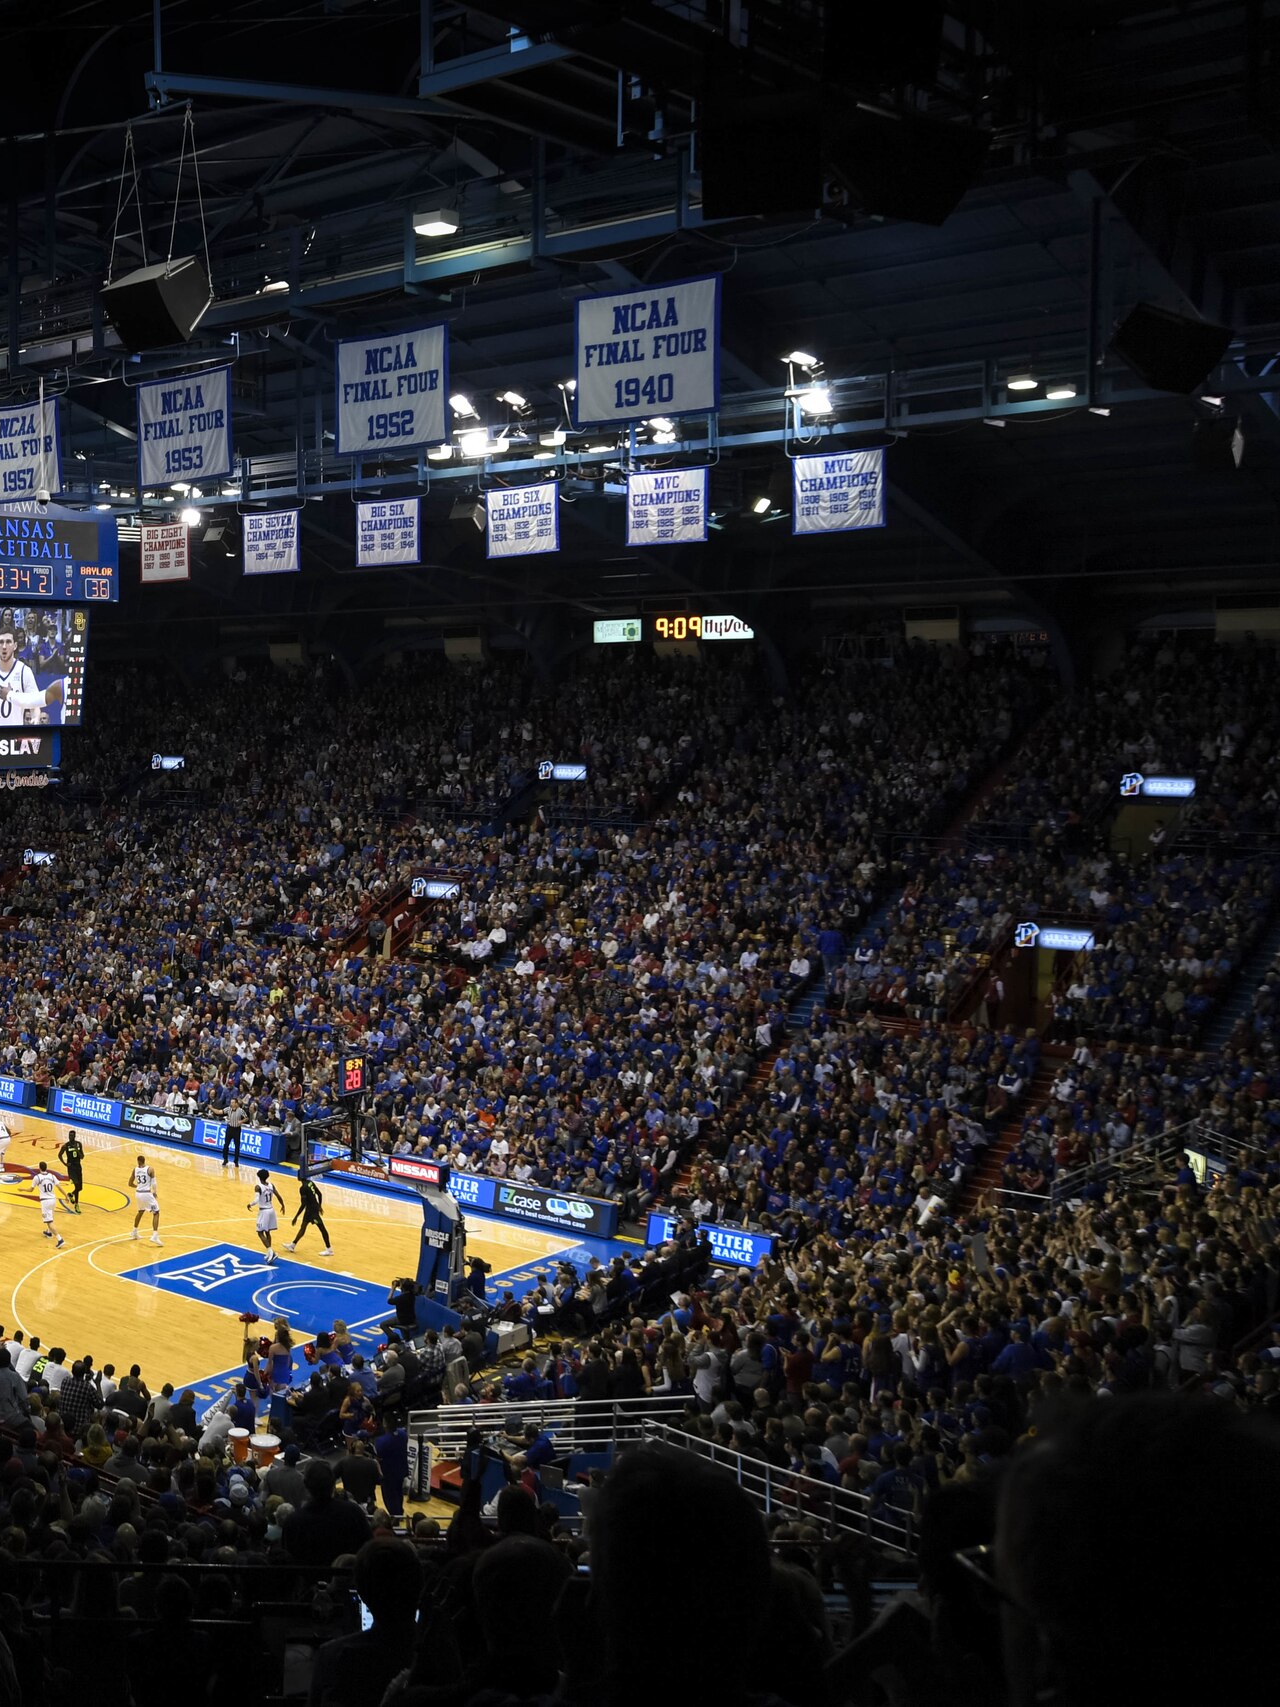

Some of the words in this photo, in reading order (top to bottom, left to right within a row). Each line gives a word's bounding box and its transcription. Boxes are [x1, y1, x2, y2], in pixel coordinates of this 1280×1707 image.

[612, 297, 678, 335] NCAA
[585, 339, 644, 367] FINAL
[653, 328, 706, 359] FOUR
[365, 342, 417, 375] NCAA
[343, 379, 392, 404] FINAL
[397, 369, 439, 397] FOUR
[615, 373, 673, 408] 1940
[161, 385, 204, 415] NCAA
[144, 418, 183, 441] FINAL
[189, 409, 224, 434] FOUR
[368, 409, 414, 441] 1952
[165, 445, 203, 474] 1953
[824, 459, 853, 474] MVC
[2, 468, 34, 492] 1957
[654, 476, 679, 490] MVC
[800, 471, 877, 492] CHAMPIONS
[502, 493, 519, 506] BIG
[524, 490, 540, 503] SIX
[633, 489, 700, 506] CHAMPIONS
[371, 506, 386, 518] BIG
[389, 504, 404, 516] SIX
[492, 503, 552, 521] CHAMPIONS
[657, 507, 674, 516] 1922
[681, 505, 699, 514] 1923
[830, 504, 848, 514] 1912
[249, 518, 262, 530] BIG
[265, 514, 292, 528] SEVEN
[361, 517, 414, 532] CHAMPIONS
[632, 520, 648, 529] 1924
[147, 530, 158, 540] BIG
[161, 527, 183, 539] EIGHT
[247, 528, 295, 542] CHAMPIONS
[492, 534, 507, 542] 1934
[657, 529, 674, 538] 1927
[144, 538, 186, 552] CHAMPIONS
[361, 543, 375, 552] 1942
[80, 566, 113, 576] BAYLOR
[38, 575, 47, 592] 2
[65, 580, 72, 596] 2
[92, 580, 107, 597] 36
[655, 616, 702, 639] 9:09
[6, 770, 49, 791] Candies
[345, 1058, 363, 1071] 18:34
[345, 1070, 361, 1090] 28
[75, 1097, 112, 1114] SHELTER
[74, 1107, 111, 1121] INSURANCE
[391, 1162, 438, 1180] NISSAN
[136, 1175, 146, 1184] 33
[43, 1183, 53, 1193] 10
[416, 1183, 428, 1193] KU
[264, 1193, 273, 1203] 11
[499, 1186, 542, 1210] EZcase
[504, 1206, 524, 1215] world's
[525, 1210, 538, 1219] best
[538, 1213, 559, 1223] contact
[559, 1217, 571, 1225] lens
[572, 1220, 586, 1229] case
[425, 1228, 450, 1242] MUSCLE
[709, 1231, 754, 1253] ELTER
[428, 1238, 445, 1249] MILK
